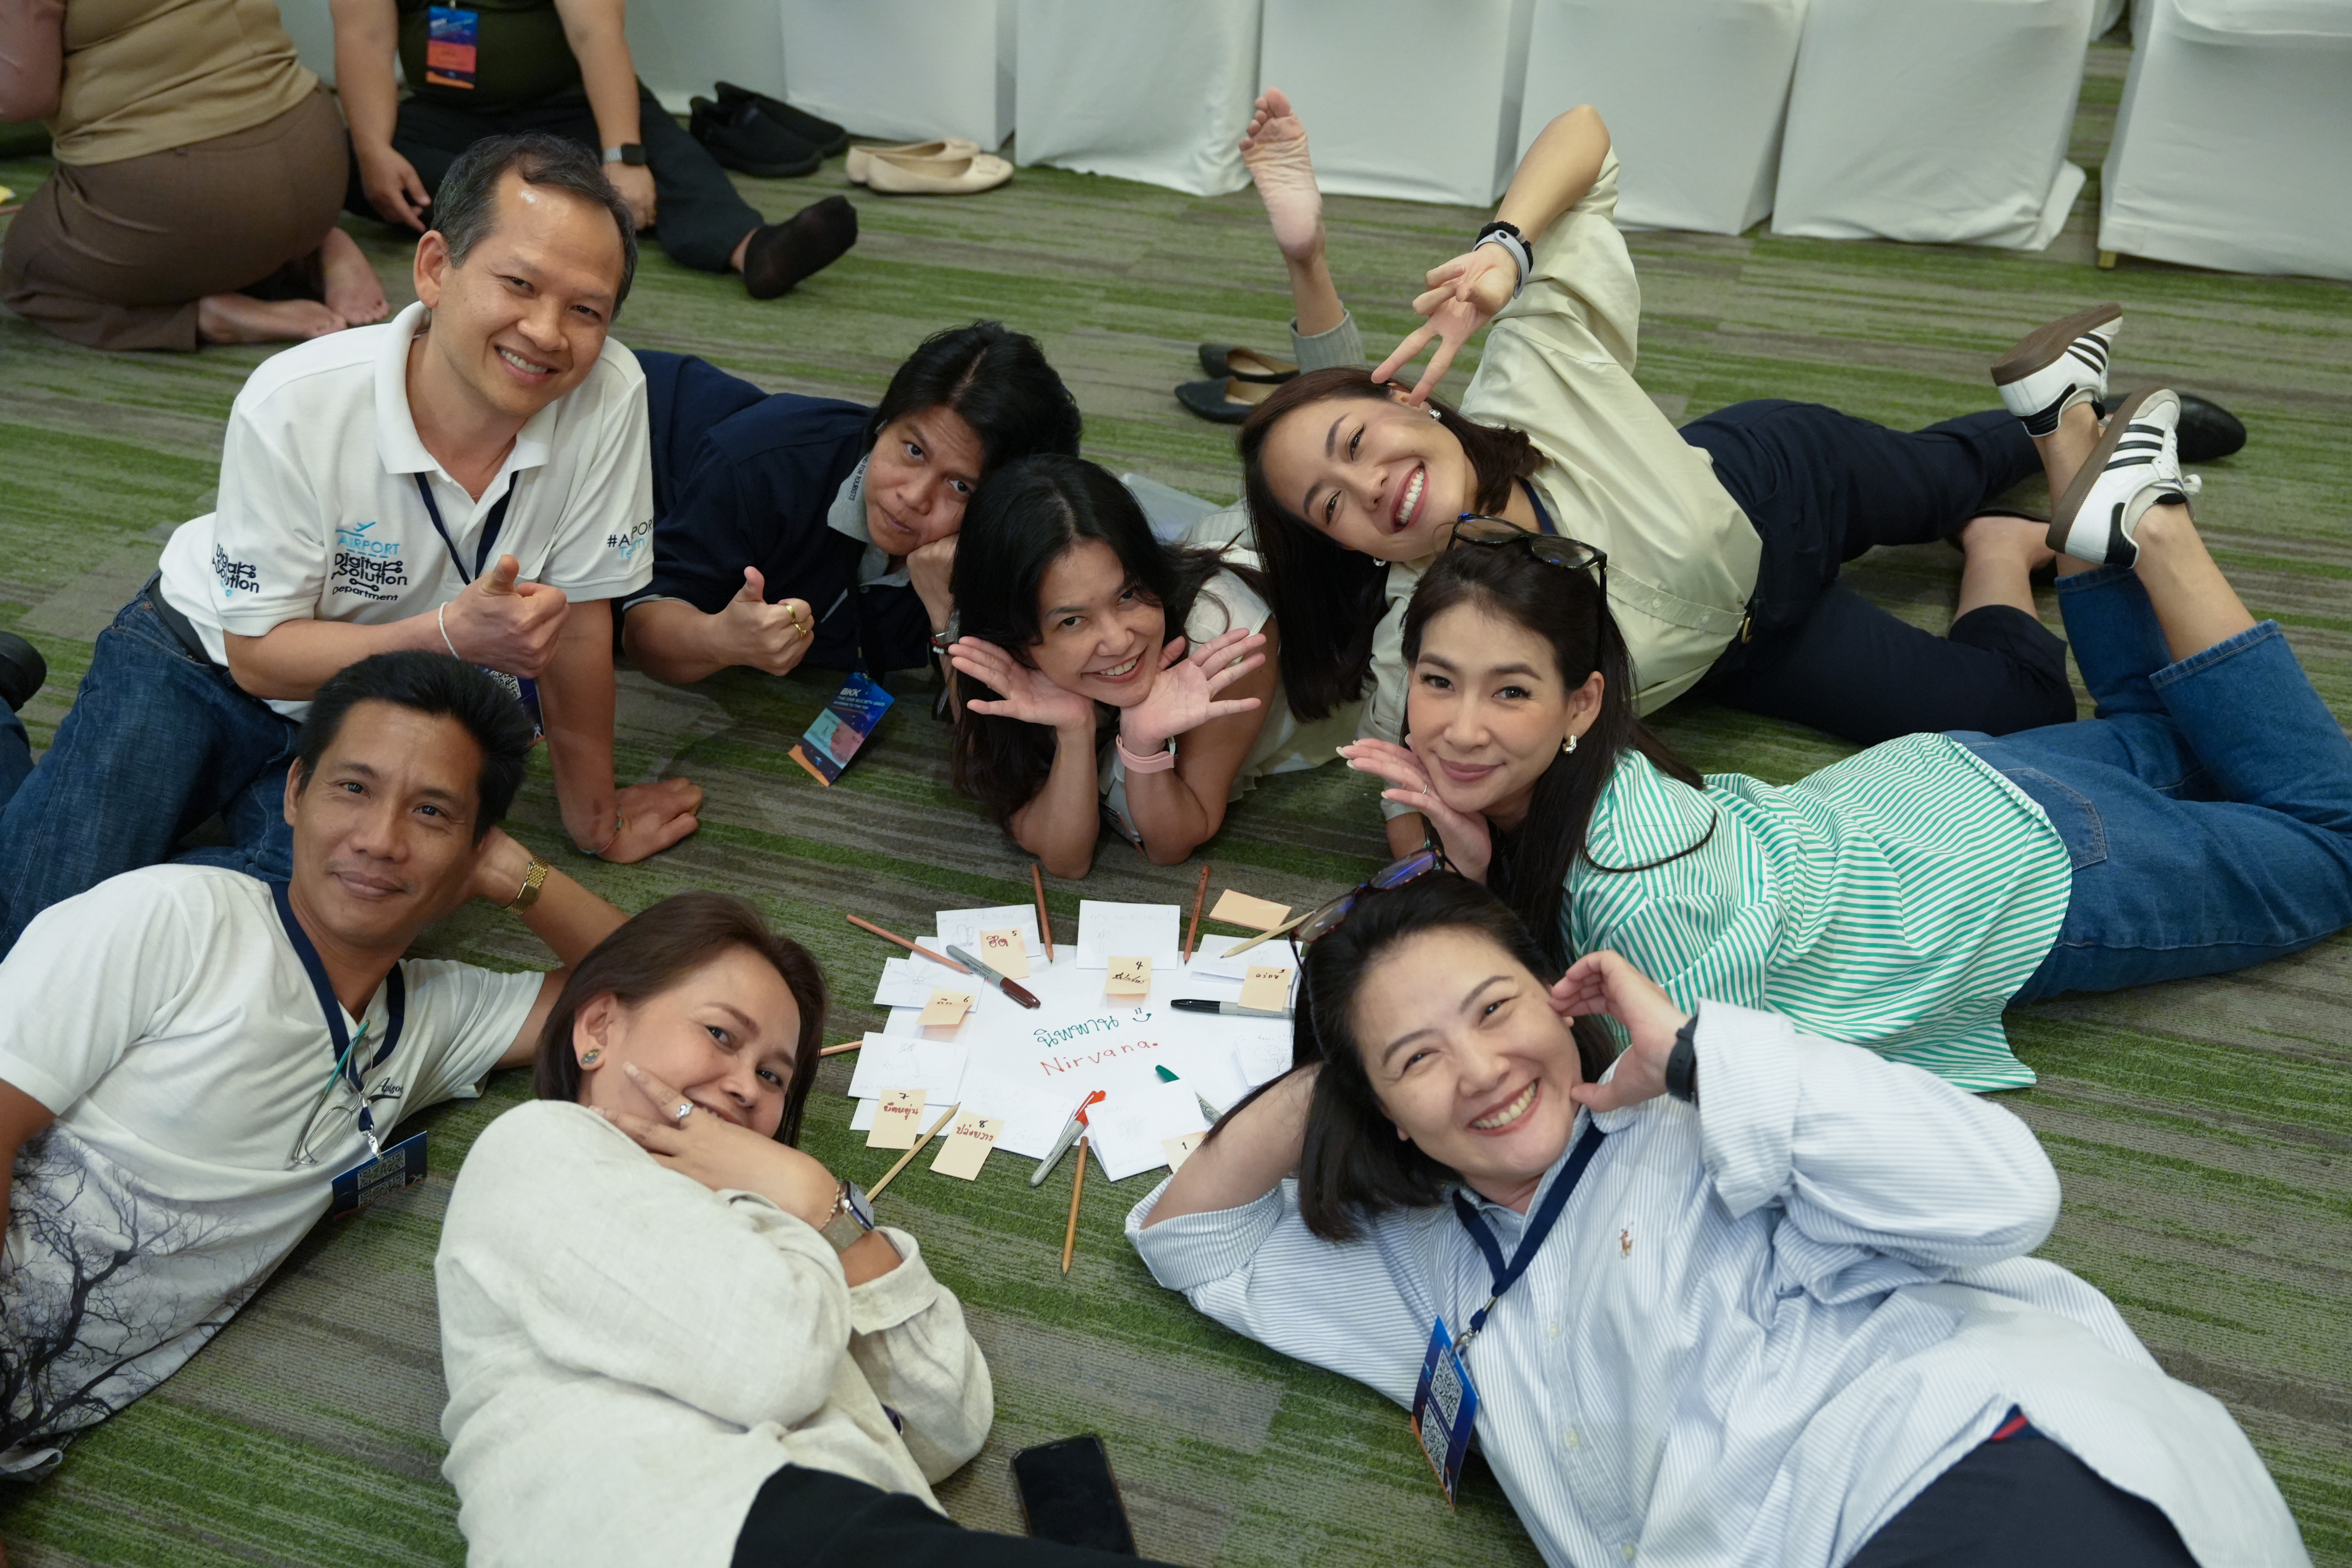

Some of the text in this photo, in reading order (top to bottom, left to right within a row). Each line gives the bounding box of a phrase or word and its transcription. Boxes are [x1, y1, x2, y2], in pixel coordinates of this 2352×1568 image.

[337, 534, 401, 555] AIRPORT
[334, 552, 389, 573] Digital
[331, 562, 408, 586] Solution
[332, 585, 399, 601] Department
[1135, 961, 1143, 970] 4
[1033, 1015, 1119, 1048] นิพพาน
[979, 1120, 989, 1128] 8
